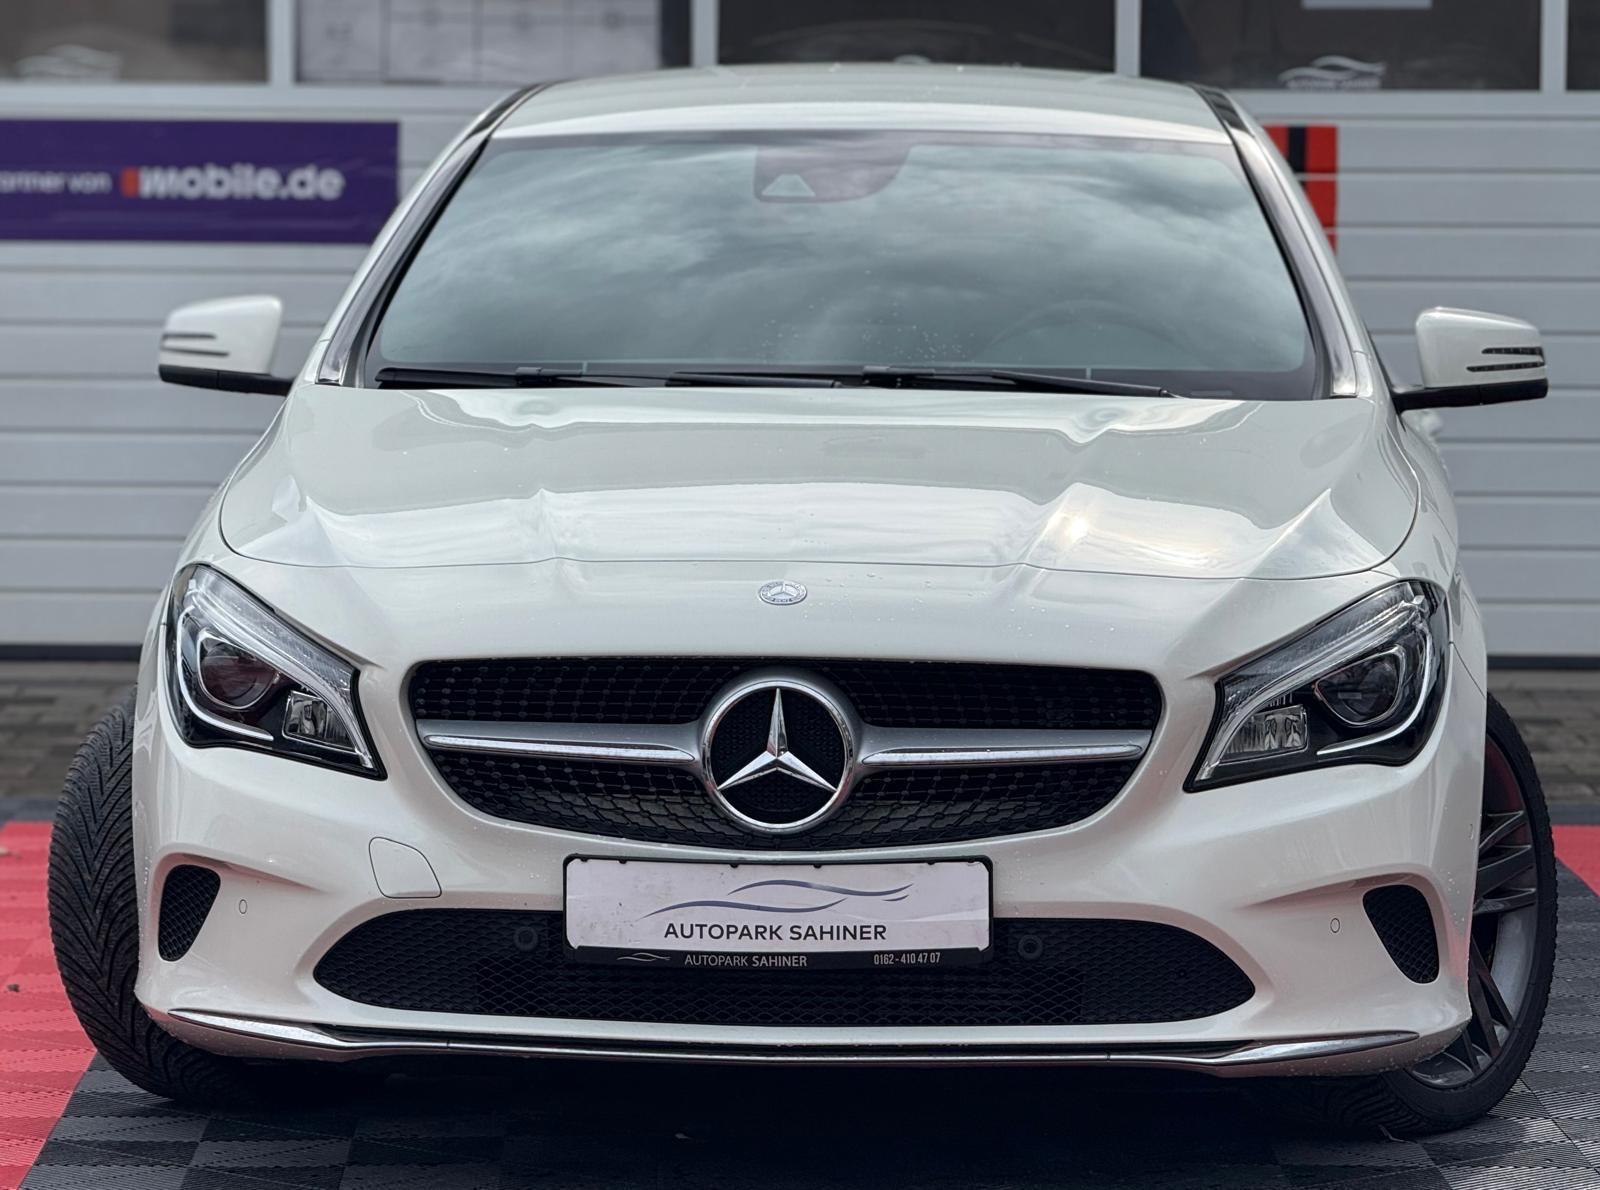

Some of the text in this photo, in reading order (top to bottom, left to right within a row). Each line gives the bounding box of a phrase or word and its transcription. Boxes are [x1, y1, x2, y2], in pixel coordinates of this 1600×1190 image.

[139, 163, 345, 200] mobile.de
[664, 923, 887, 941] AUTOPARK SAHINER
[684, 954, 808, 967] AUTOPARK SAHINER
